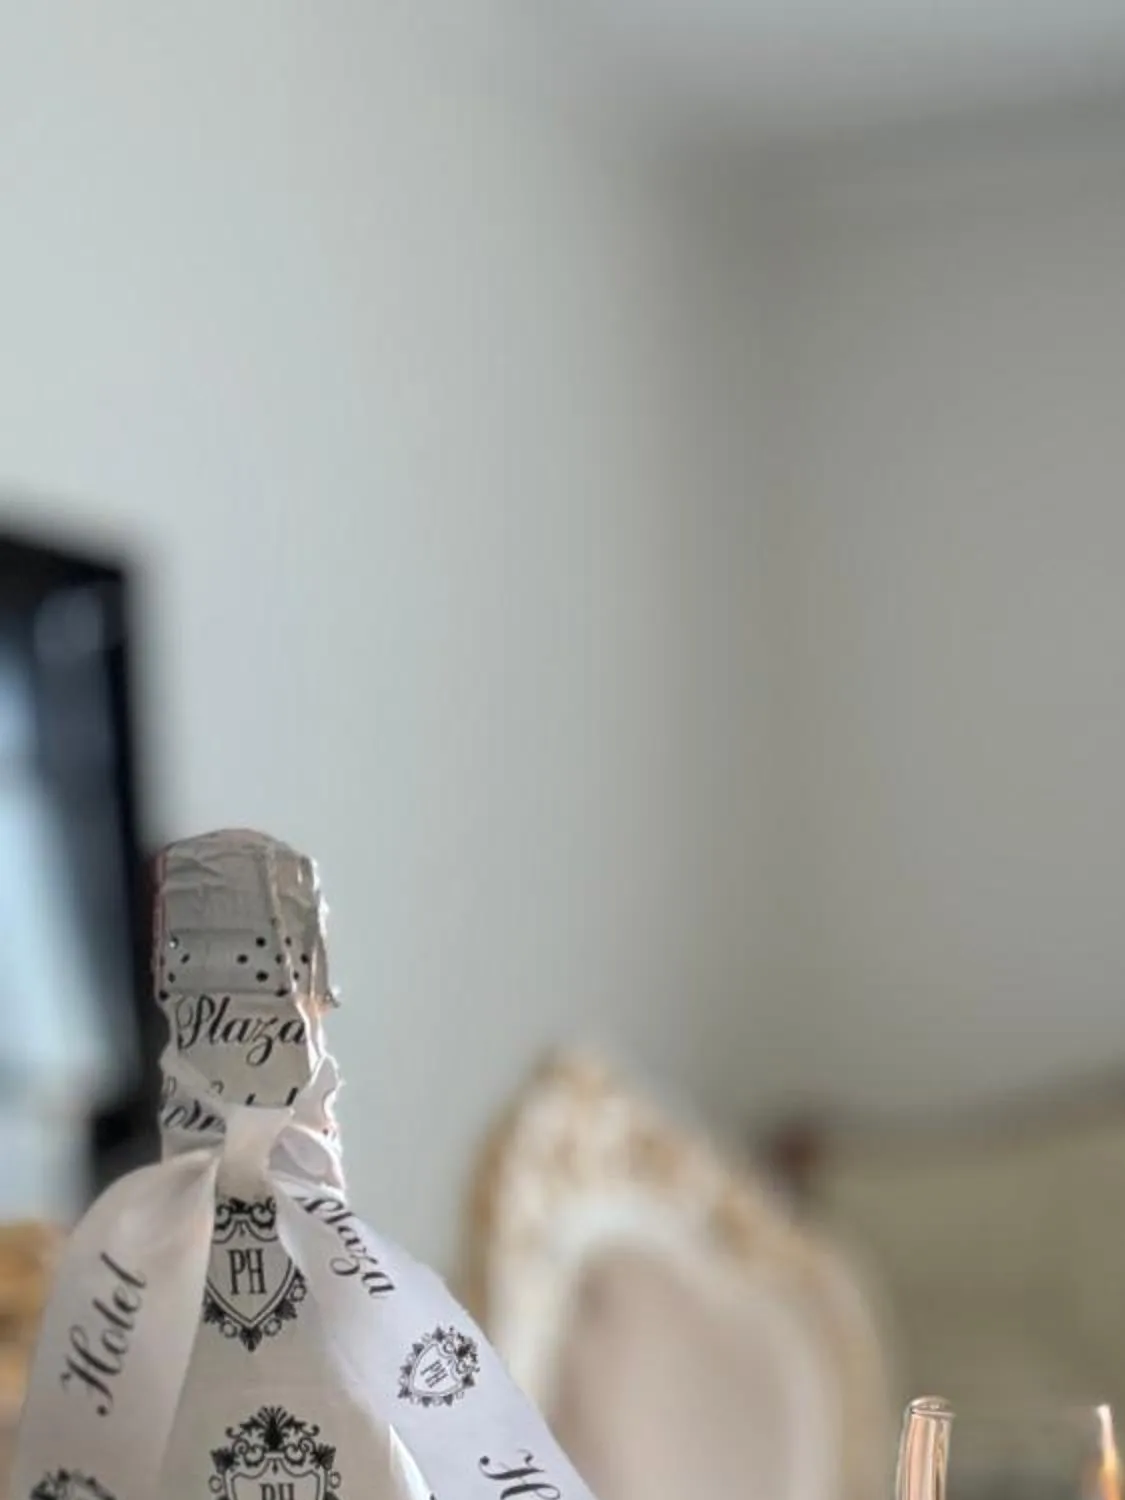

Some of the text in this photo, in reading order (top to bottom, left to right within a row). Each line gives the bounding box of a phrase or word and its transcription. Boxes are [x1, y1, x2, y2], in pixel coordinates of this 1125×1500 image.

[175, 995, 308, 1066] Plaza
[228, 1248, 267, 1295] PH
[292, 1197, 395, 1299] Plaza
[60, 1252, 146, 1416] Hotel
